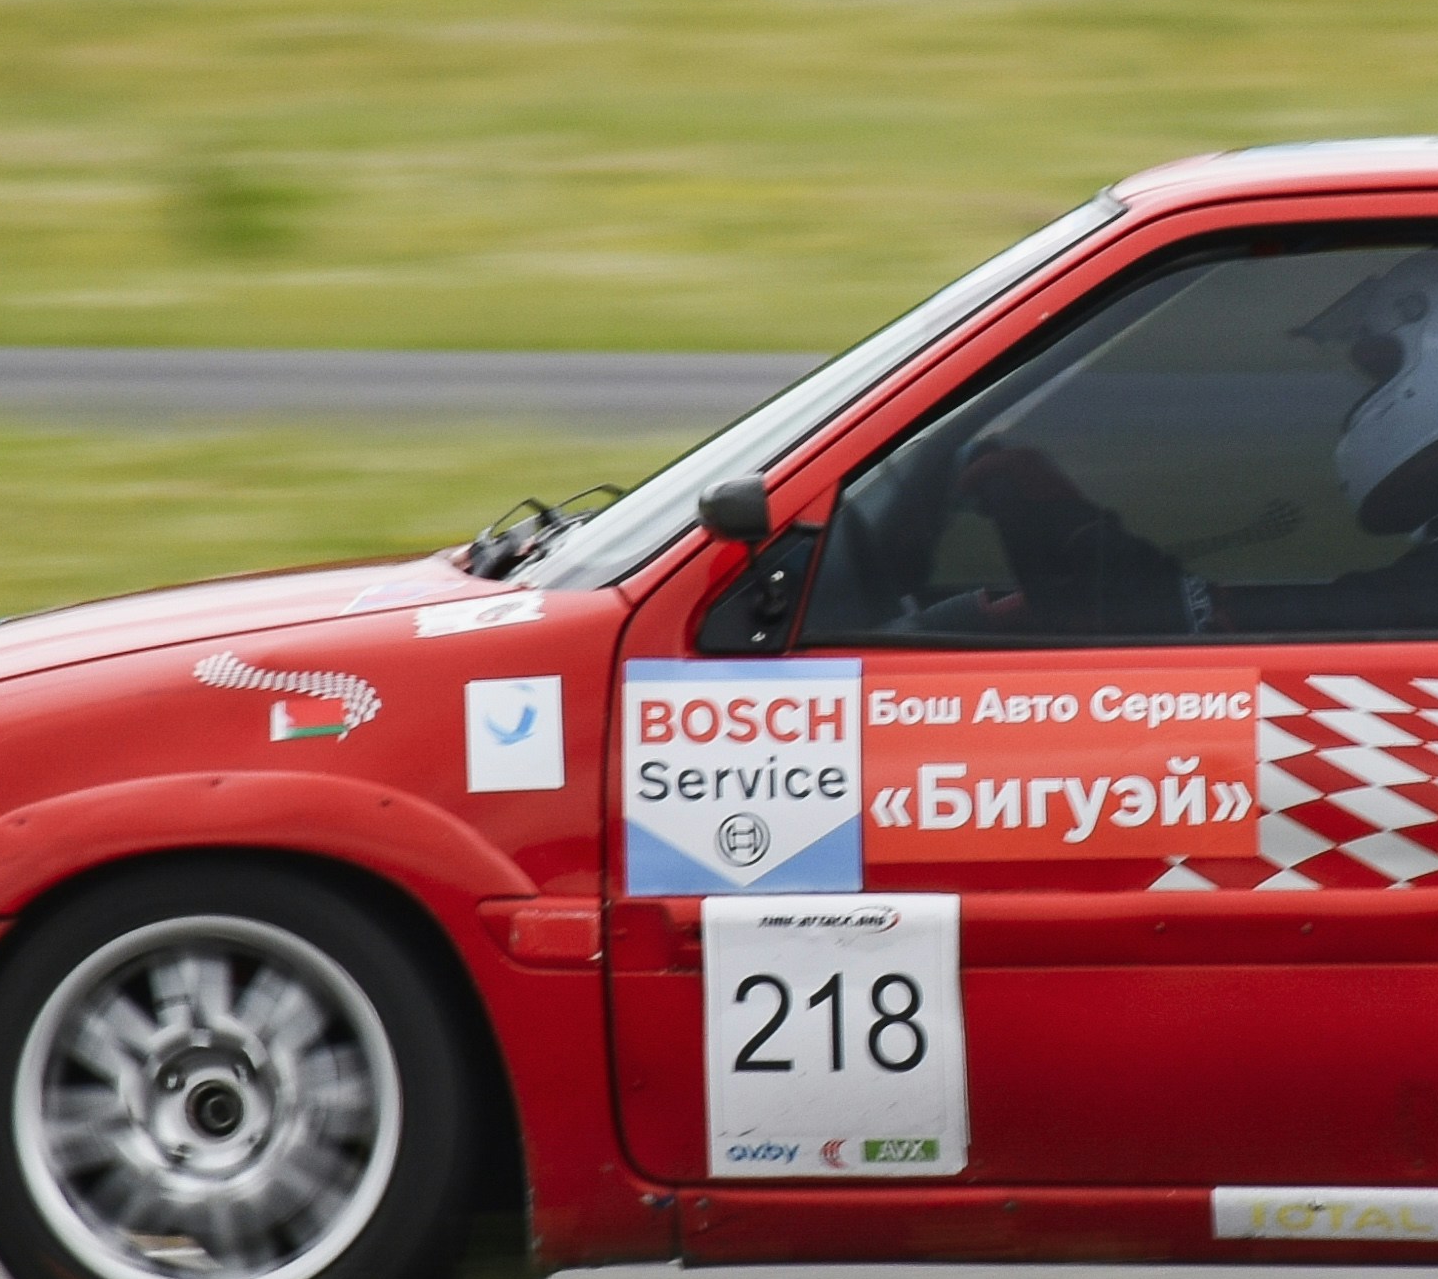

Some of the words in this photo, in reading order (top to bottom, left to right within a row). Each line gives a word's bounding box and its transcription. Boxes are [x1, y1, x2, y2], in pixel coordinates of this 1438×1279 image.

[639, 697, 846, 745] BOSCH
[868, 689, 961, 725] Бош
[972, 687, 1079, 724] Авто
[1090, 684, 1253, 728] Сервис
[637, 755, 848, 803] Service
[870, 755, 1253, 844] «Бигуэй»
[733, 972, 927, 1074] 218
[1250, 1201, 1433, 1234] TOTAL
